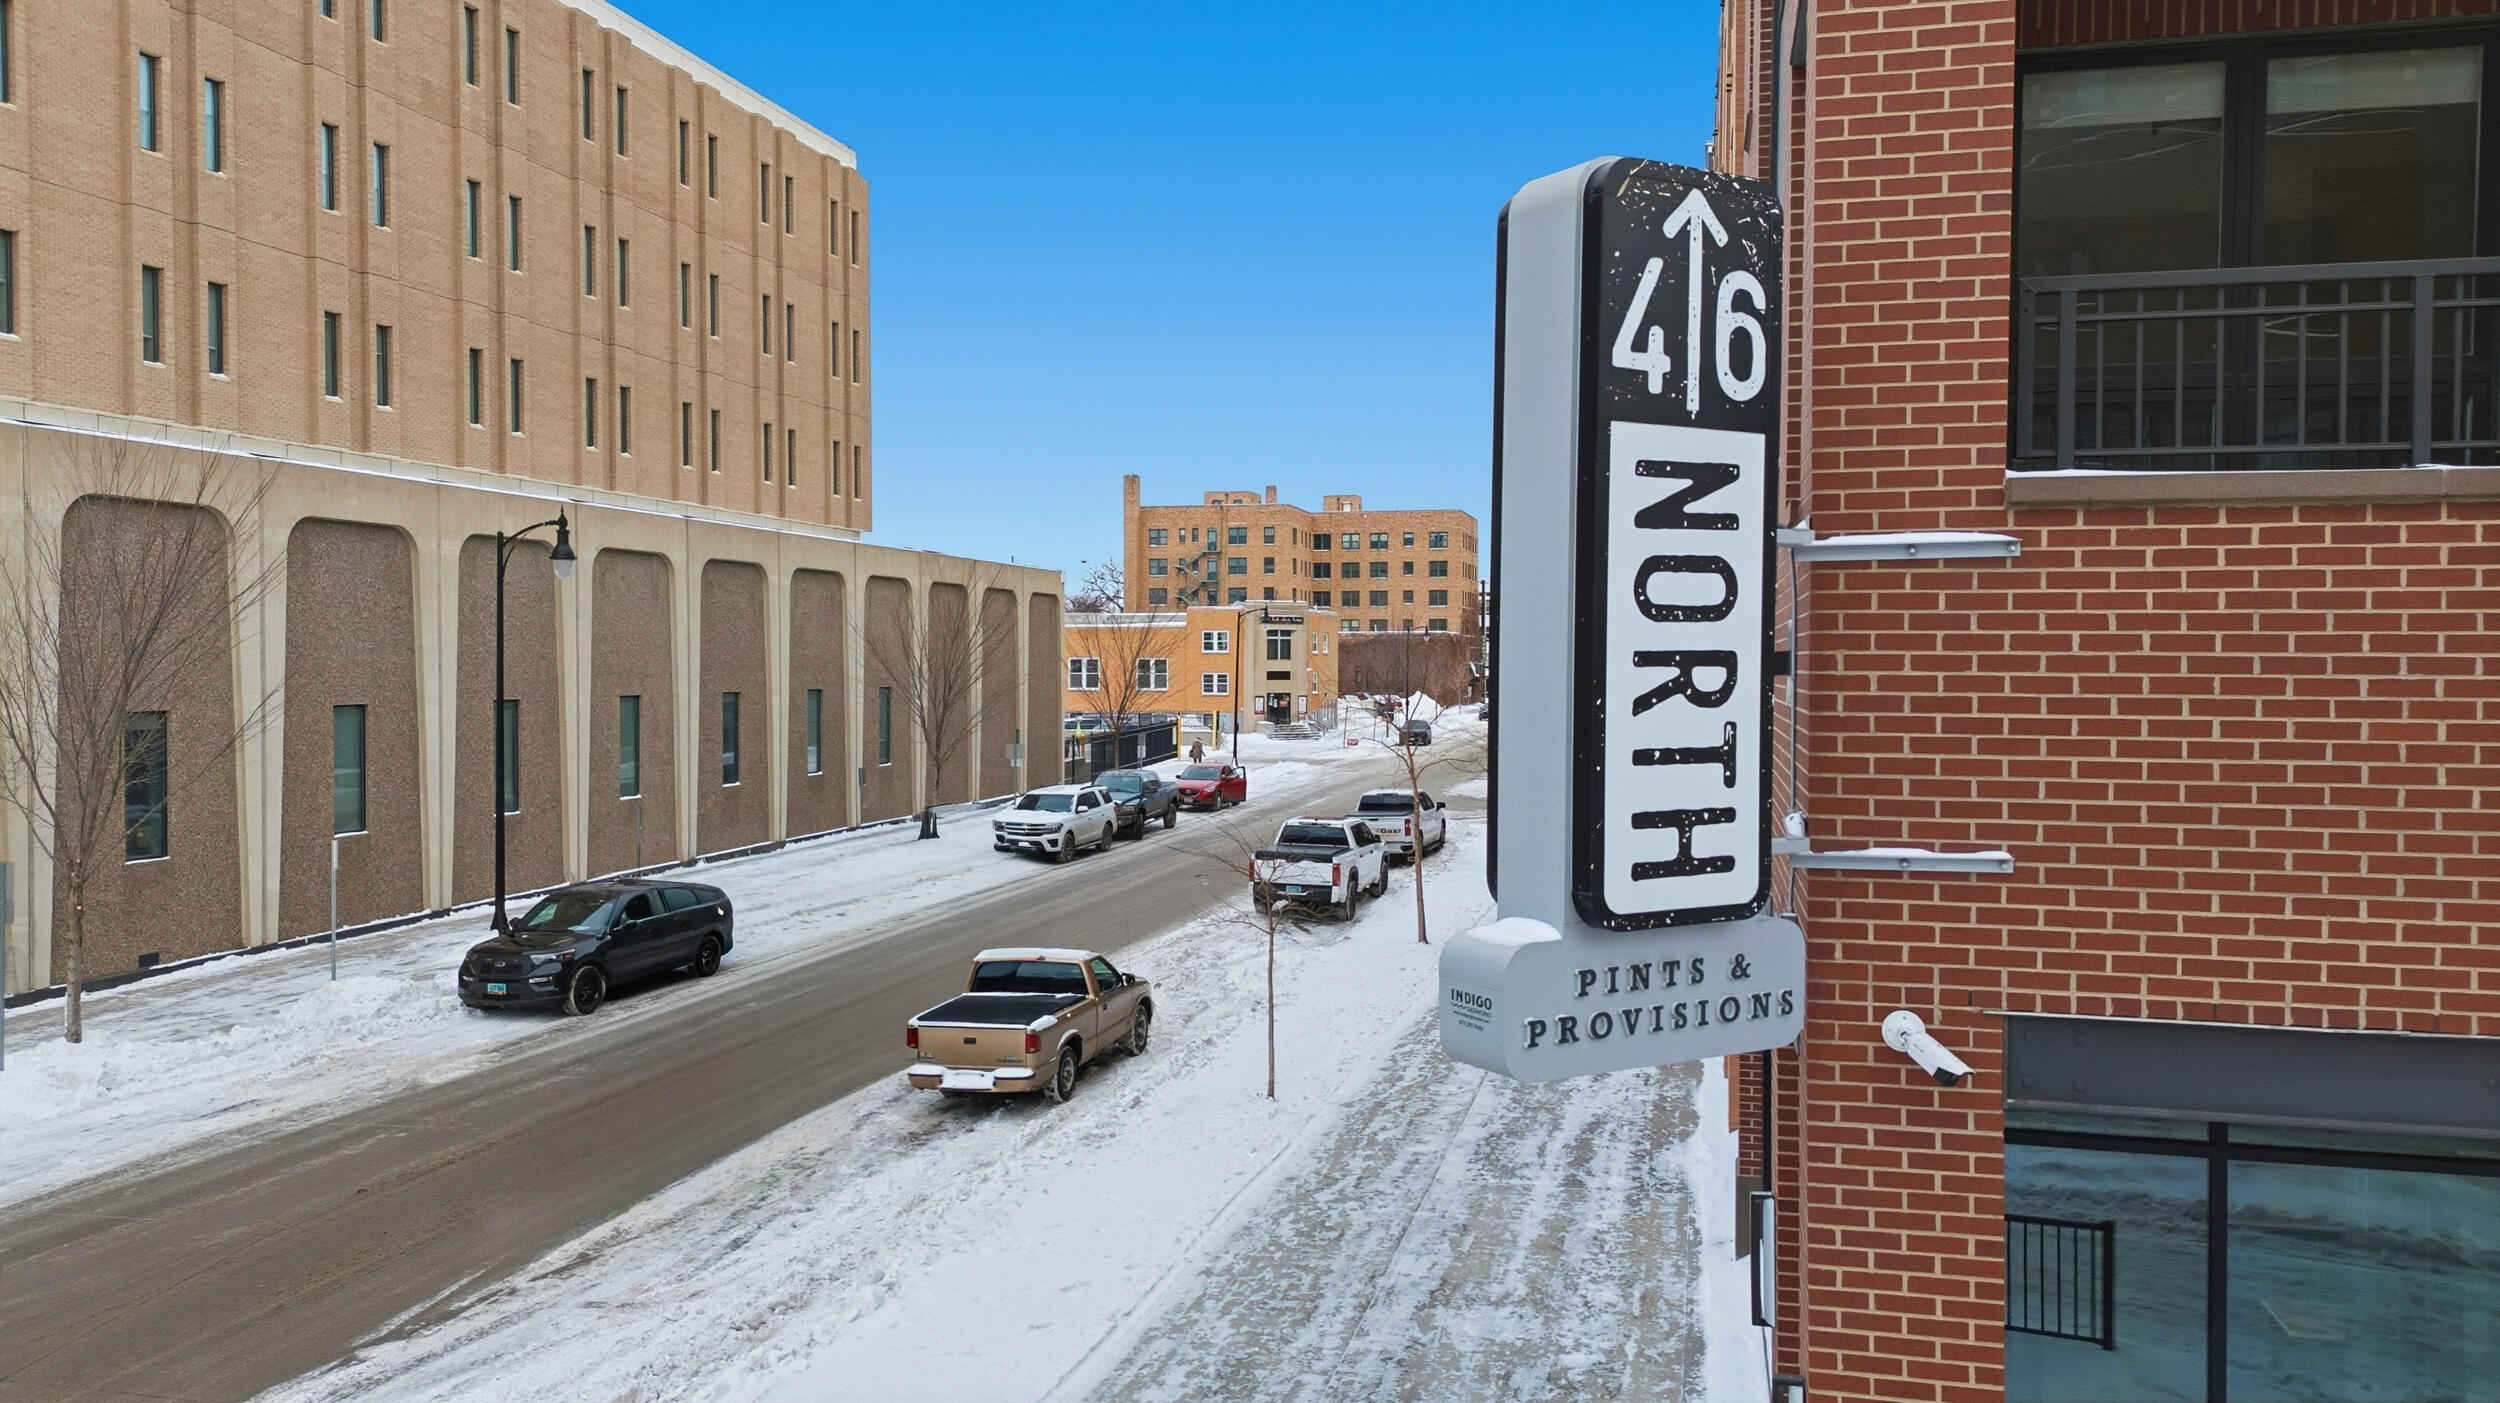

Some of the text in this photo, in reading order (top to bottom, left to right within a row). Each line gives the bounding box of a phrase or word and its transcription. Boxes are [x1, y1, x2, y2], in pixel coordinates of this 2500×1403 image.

[1631, 459, 1740, 882] NORTH
[1451, 988, 1492, 1010] INDIGO
[1575, 953, 1751, 997] PINTS &
[1523, 989, 1794, 1049] PROVISIONS
